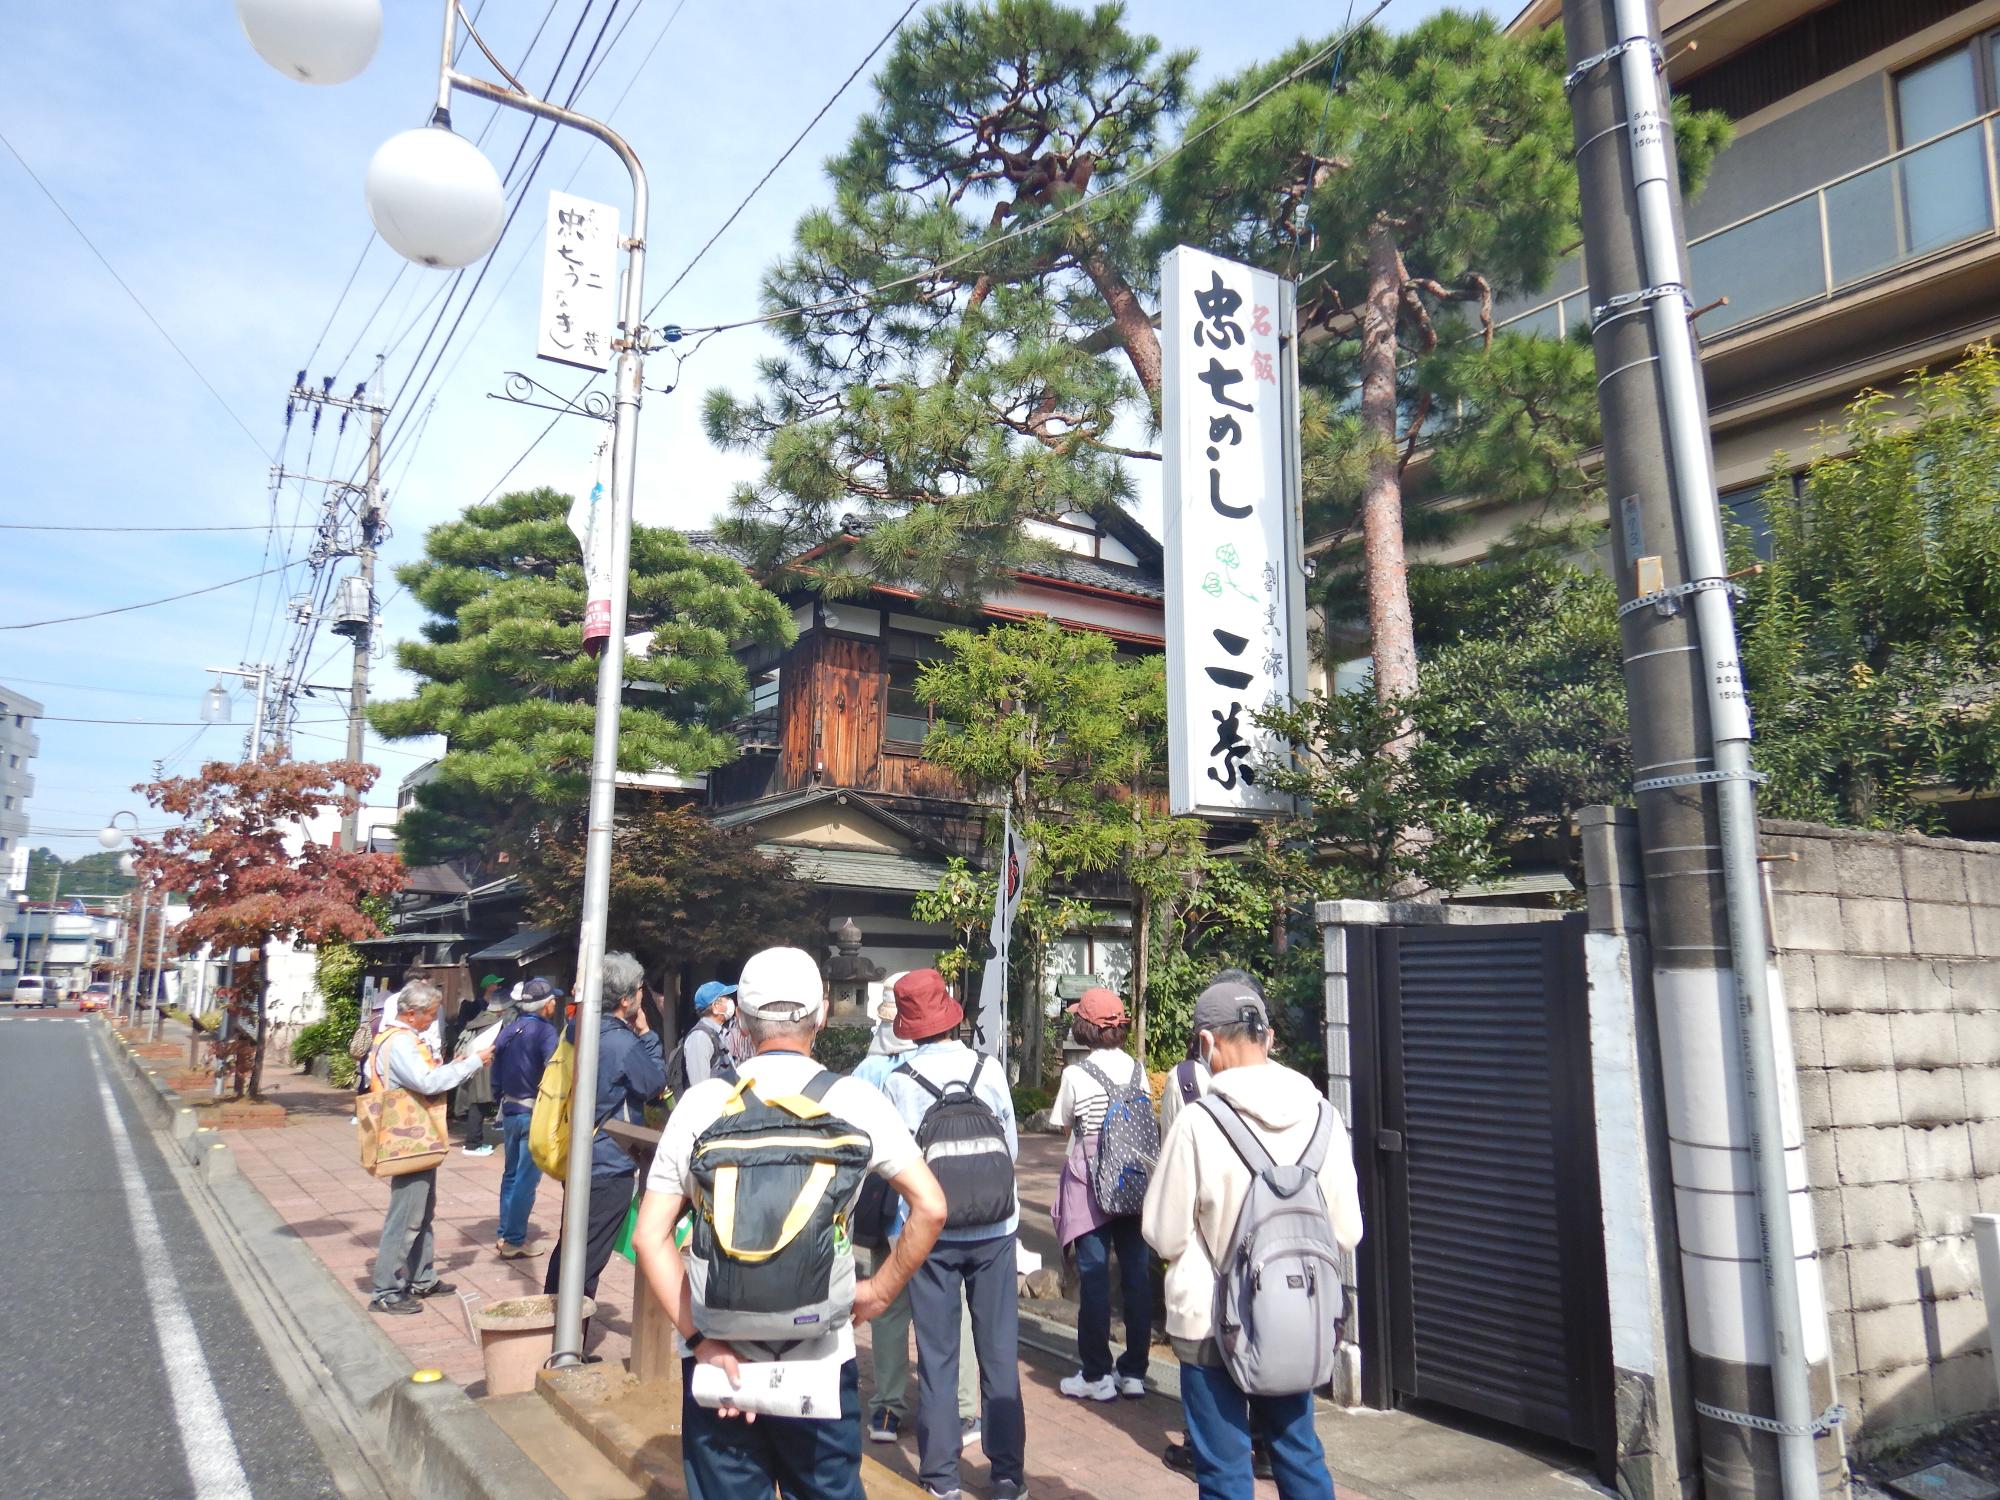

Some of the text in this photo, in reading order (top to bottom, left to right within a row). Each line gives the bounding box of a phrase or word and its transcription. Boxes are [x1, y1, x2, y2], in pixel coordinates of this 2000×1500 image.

[1193, 269, 1255, 520] 忠七めし
[1250, 303, 1277, 386] 名飯
